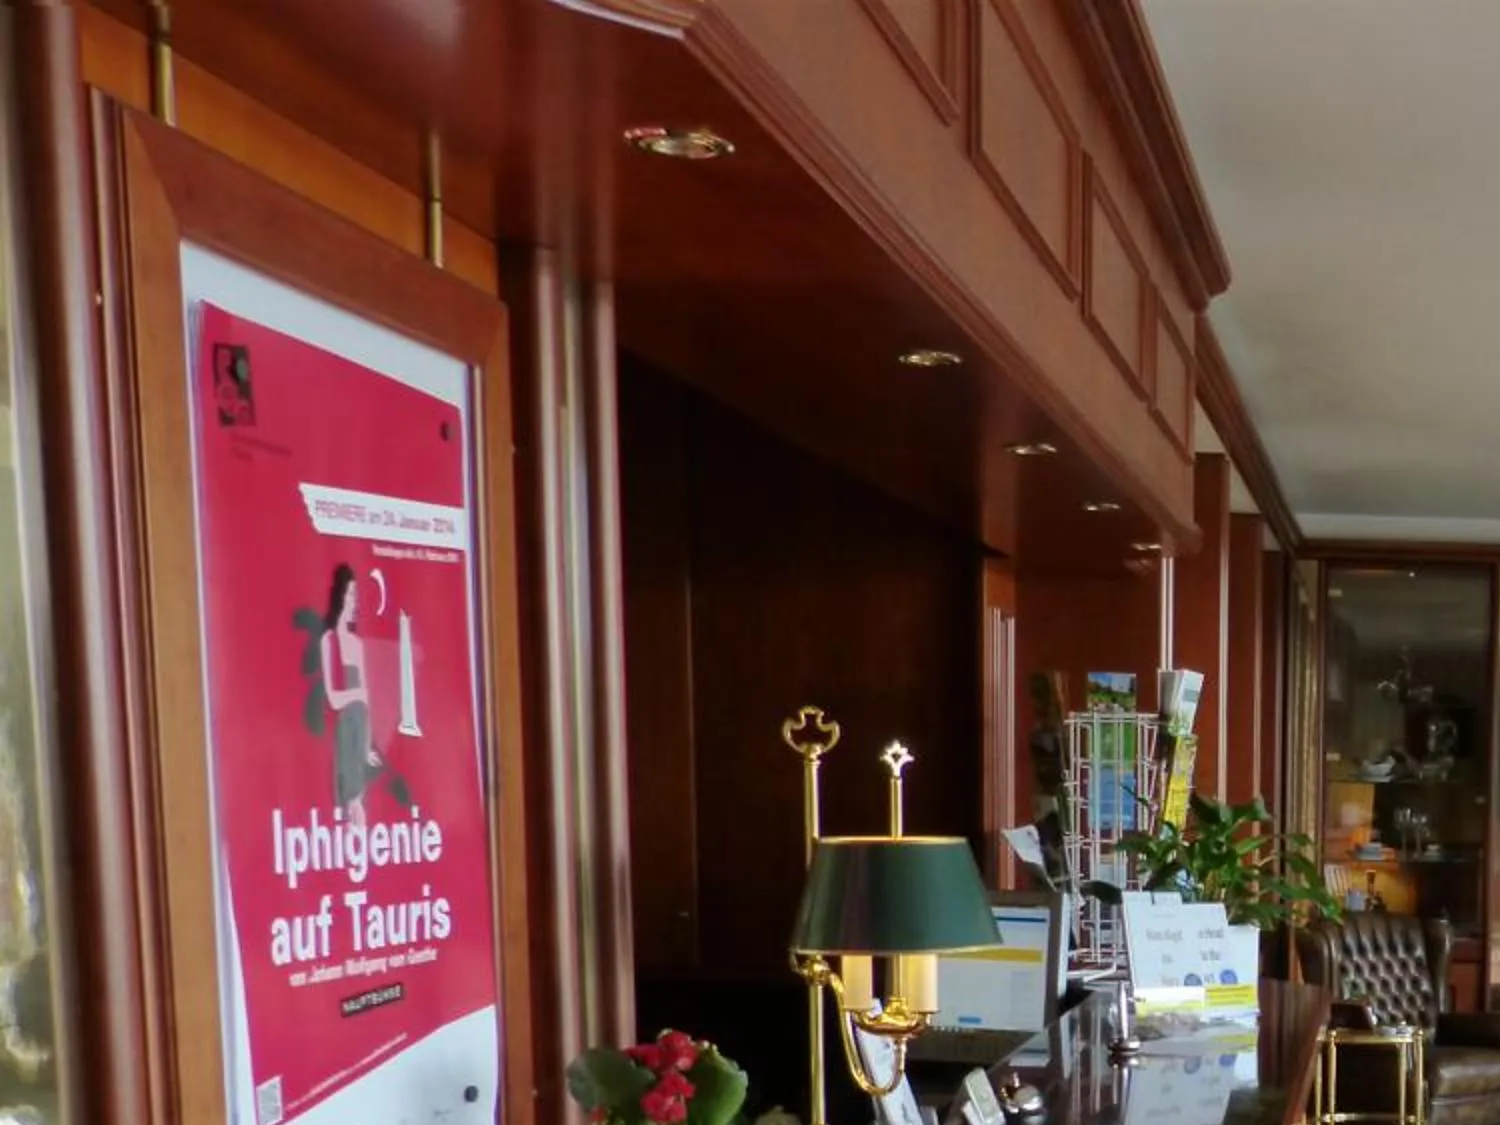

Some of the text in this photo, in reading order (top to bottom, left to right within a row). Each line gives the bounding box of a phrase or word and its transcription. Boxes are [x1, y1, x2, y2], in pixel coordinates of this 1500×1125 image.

[272, 804, 443, 890] Iphigenie
[271, 883, 451, 968] auf Tauris
